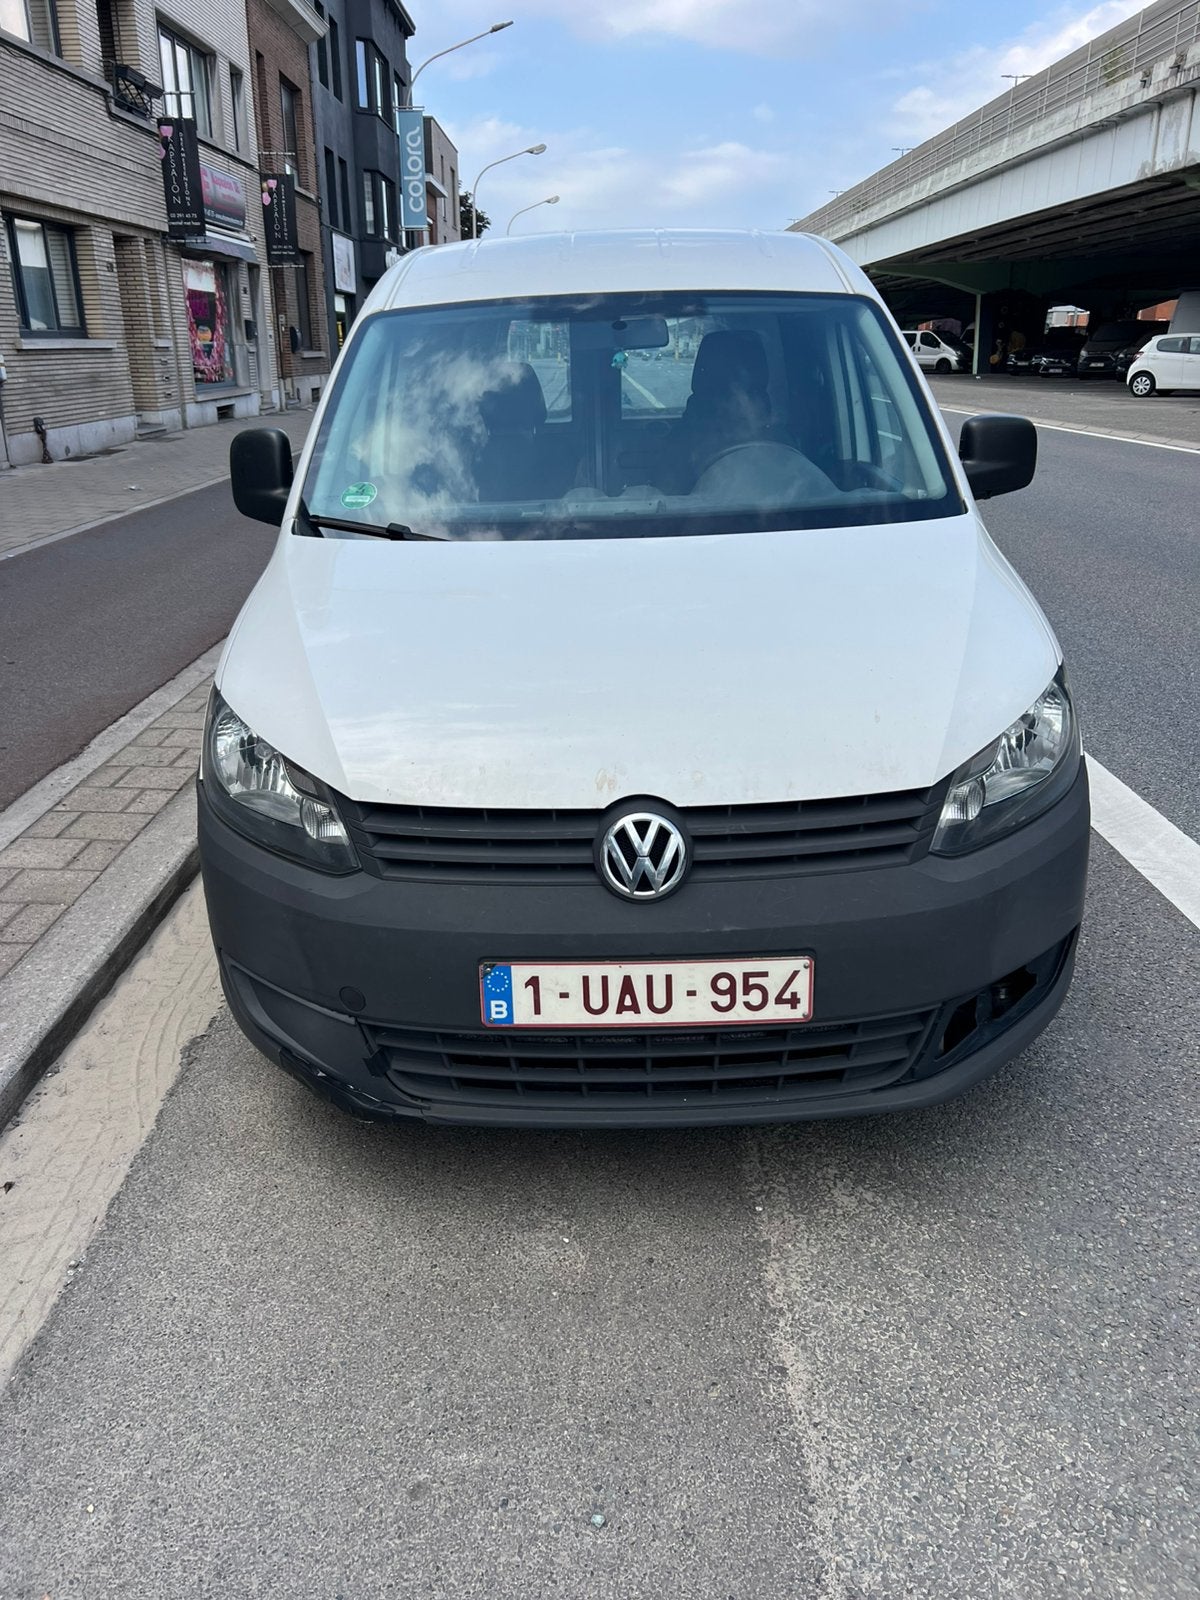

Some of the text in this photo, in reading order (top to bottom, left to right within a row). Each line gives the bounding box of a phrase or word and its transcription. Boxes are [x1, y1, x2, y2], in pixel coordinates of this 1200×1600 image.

[167, 135, 181, 204] KAPSALON
[404, 125, 424, 213] colora
[490, 1000, 508, 1019] B
[524, 969, 801, 1016] 1-UAU-954
